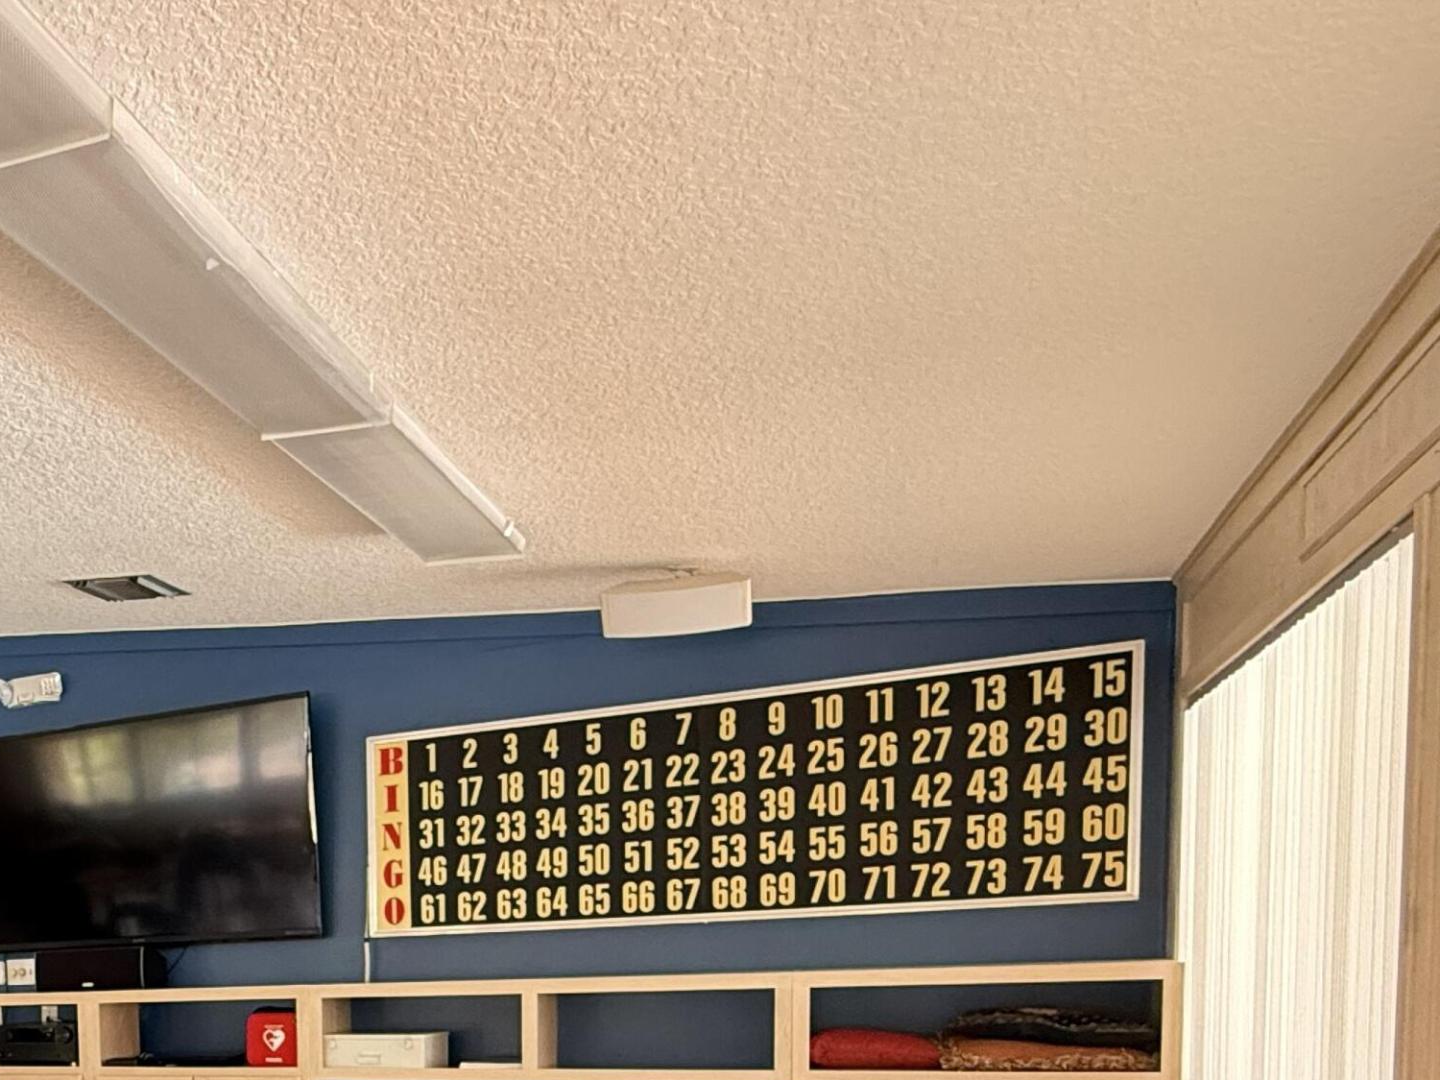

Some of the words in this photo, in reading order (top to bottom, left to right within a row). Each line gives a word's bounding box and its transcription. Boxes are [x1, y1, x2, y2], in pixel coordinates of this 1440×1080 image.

[418, 779, 445, 811] 16
[457, 775, 484, 807] 17
[497, 770, 524, 804] 18
[537, 766, 565, 800] 19
[577, 761, 611, 797] 20
[622, 757, 653, 793] 21
[665, 752, 700, 788] 22
[710, 748, 746, 785] 23
[758, 743, 796, 780] 24
[807, 736, 845, 775] 25
[858, 731, 898, 769] 26
[911, 725, 953, 765] 27
[966, 719, 1009, 760] 28
[1024, 713, 1068, 753] 29
[1083, 706, 1128, 747] 30
[425, 742, 437, 773] 1
[462, 737, 478, 769] 2
[502, 732, 518, 765] 3
[542, 728, 560, 760] 4
[585, 722, 602, 756] 5
[630, 717, 647, 751] 6
[675, 711, 693, 746] 7
[718, 707, 737, 742] 8
[768, 701, 786, 736] 9
[810, 693, 844, 730] 10
[865, 687, 894, 724] 11
[915, 681, 950, 719] 12
[971, 674, 1007, 712] 13
[1028, 666, 1066, 706] 14
[1089, 658, 1126, 698] 15
[379, 748, 406, 926] BINGO
[417, 855, 448, 887] 46
[456, 852, 487, 884] 47
[495, 848, 528, 882] 48
[535, 846, 568, 879] 49
[578, 842, 611, 877] 50
[623, 839, 653, 874] 51
[666, 836, 700, 871] 52
[711, 833, 747, 869] 53
[758, 829, 796, 865] 54
[808, 824, 846, 861] 55
[859, 820, 898, 858] 56
[912, 816, 952, 854] 57
[965, 812, 1008, 851] 58
[1023, 807, 1066, 847] 59
[1082, 802, 1126, 842] 60
[418, 817, 445, 850] 31
[455, 814, 486, 847] 32
[495, 810, 527, 844] 33
[535, 806, 568, 840] 34
[577, 802, 610, 837] 35
[621, 798, 655, 833] 36
[666, 794, 701, 830] 37
[710, 790, 747, 827] 38
[758, 785, 796, 823] 39
[808, 780, 847, 817] 40
[859, 776, 895, 813] 41
[911, 771, 953, 809] 42
[966, 765, 1009, 804] 43
[1022, 760, 1068, 799] 44
[1082, 754, 1127, 794] 45
[420, 893, 446, 925] 61
[457, 890, 487, 923] 62
[496, 887, 527, 921] 63
[536, 885, 569, 919] 64
[578, 882, 611, 916] 65
[621, 879, 656, 914] 66
[666, 877, 701, 912] 67
[711, 874, 748, 910] 68
[759, 871, 796, 907] 69
[808, 867, 846, 904] 70
[861, 864, 896, 901] 71
[910, 861, 951, 898] 72
[965, 857, 1007, 896] 73
[1022, 854, 1065, 892] 74
[1081, 850, 1125, 889] 75
